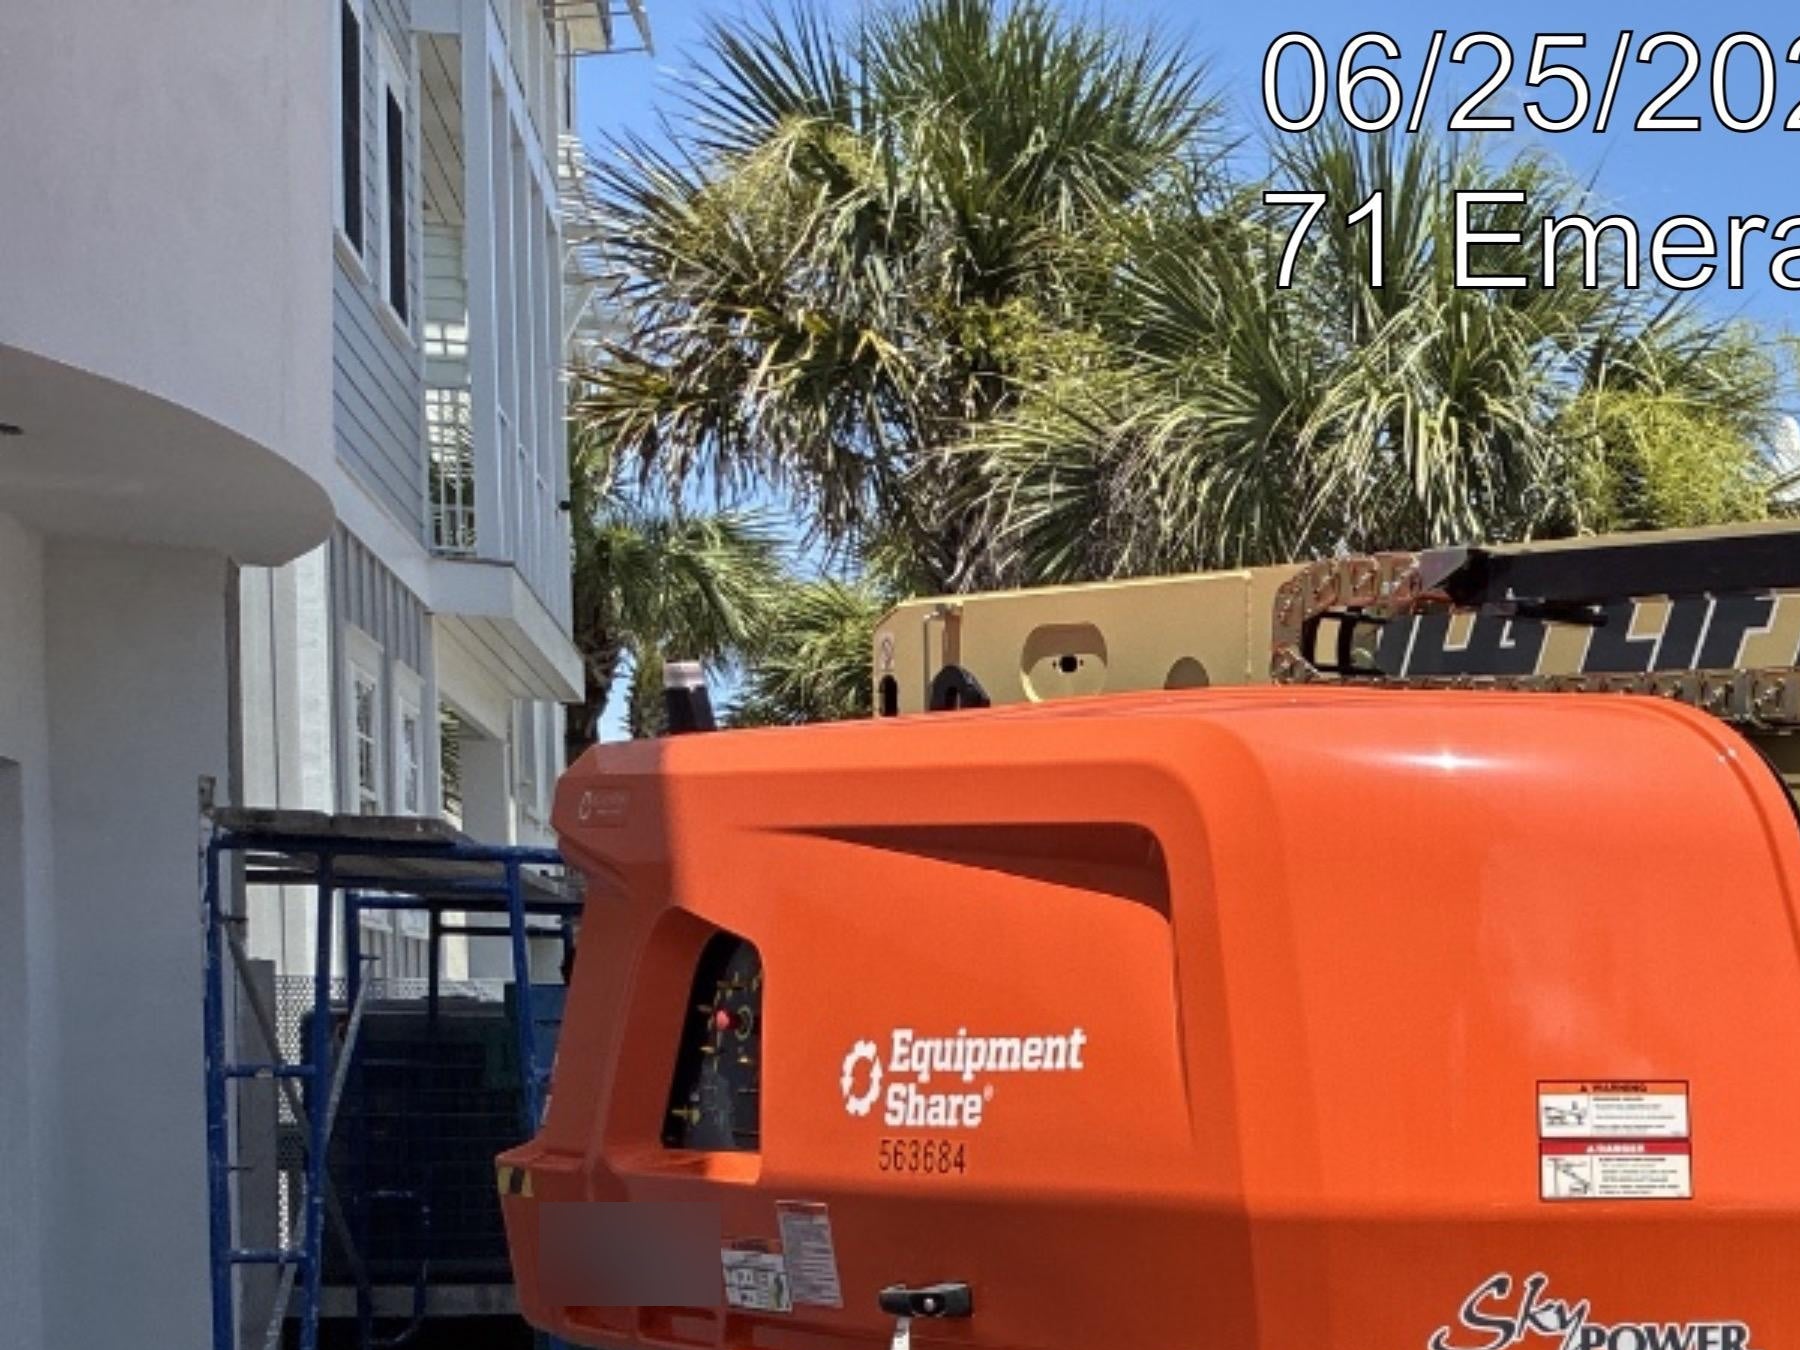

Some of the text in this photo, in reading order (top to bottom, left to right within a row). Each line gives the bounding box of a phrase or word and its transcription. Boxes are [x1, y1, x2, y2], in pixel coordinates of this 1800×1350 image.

[888, 1026, 1087, 1084] Equipment
[883, 1082, 983, 1128] Share
[878, 1138, 967, 1175] 563684
